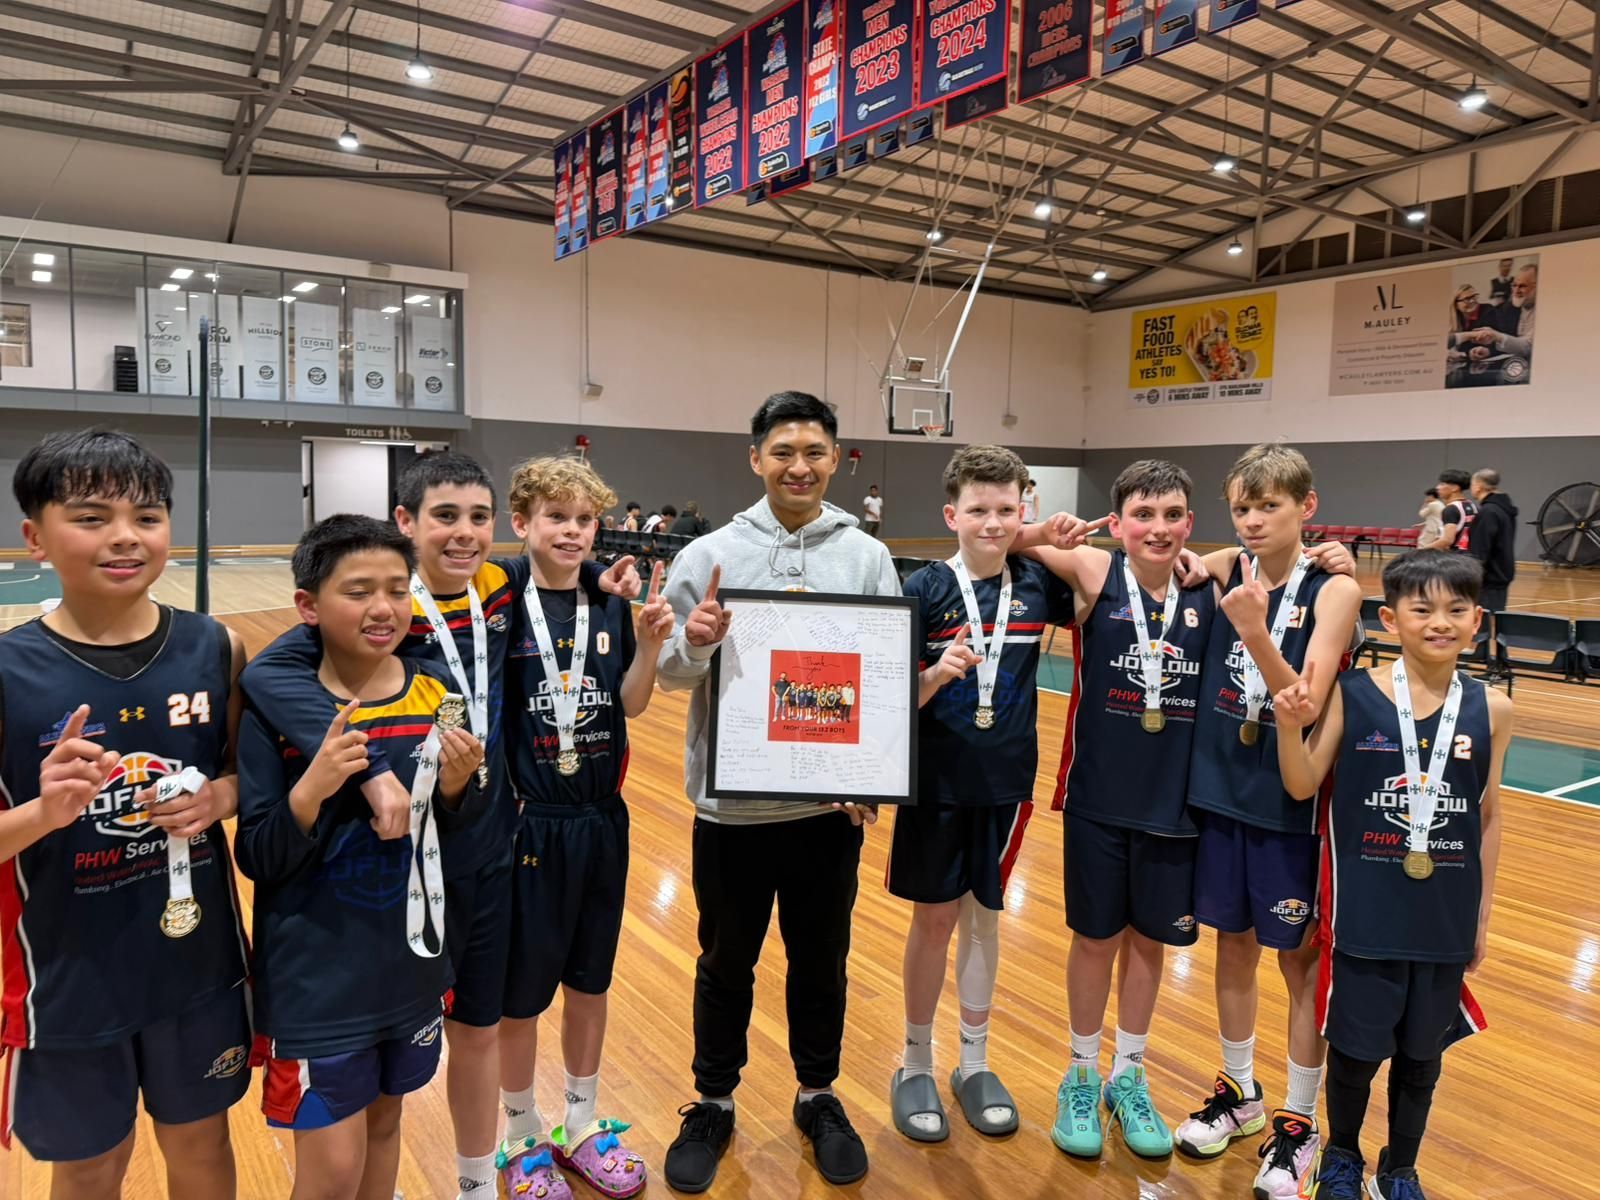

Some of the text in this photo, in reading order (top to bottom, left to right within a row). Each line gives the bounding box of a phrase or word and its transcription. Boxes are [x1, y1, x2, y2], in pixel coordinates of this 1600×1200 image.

[930, 0, 997, 38] CHAMPIONS
[1038, 0, 1073, 32] 2006
[850, 24, 908, 68] CHAMPIONS
[936, 17, 987, 68] 2024
[855, 49, 900, 96] 2023
[758, 121, 790, 157] 2022
[704, 145, 733, 178] 2022
[1143, 315, 1176, 333] FAST
[304, 339, 330, 348] STONE
[1143, 331, 1175, 347] FOOD
[1135, 344, 1182, 361] ATHLETES
[1139, 365, 1176, 380] YES TO!
[345, 428, 384, 438] TOILETS
[1183, 607, 1199, 628] 6
[596, 631, 610, 655] 0
[1109, 654, 1200, 675] JOOW
[527, 691, 613, 712] JOOW
[1107, 688, 1141, 703] PHW
[1143, 692, 1197, 708] rvices
[1218, 687, 1239, 702] PHW
[167, 690, 211, 727] 24
[573, 730, 611, 743] ervices
[1454, 734, 1472, 760] 2
[74, 831, 208, 870] PHW Serves
[1362, 831, 1465, 851] PHW Srvices
[1270, 906, 1312, 916] JOFLO
